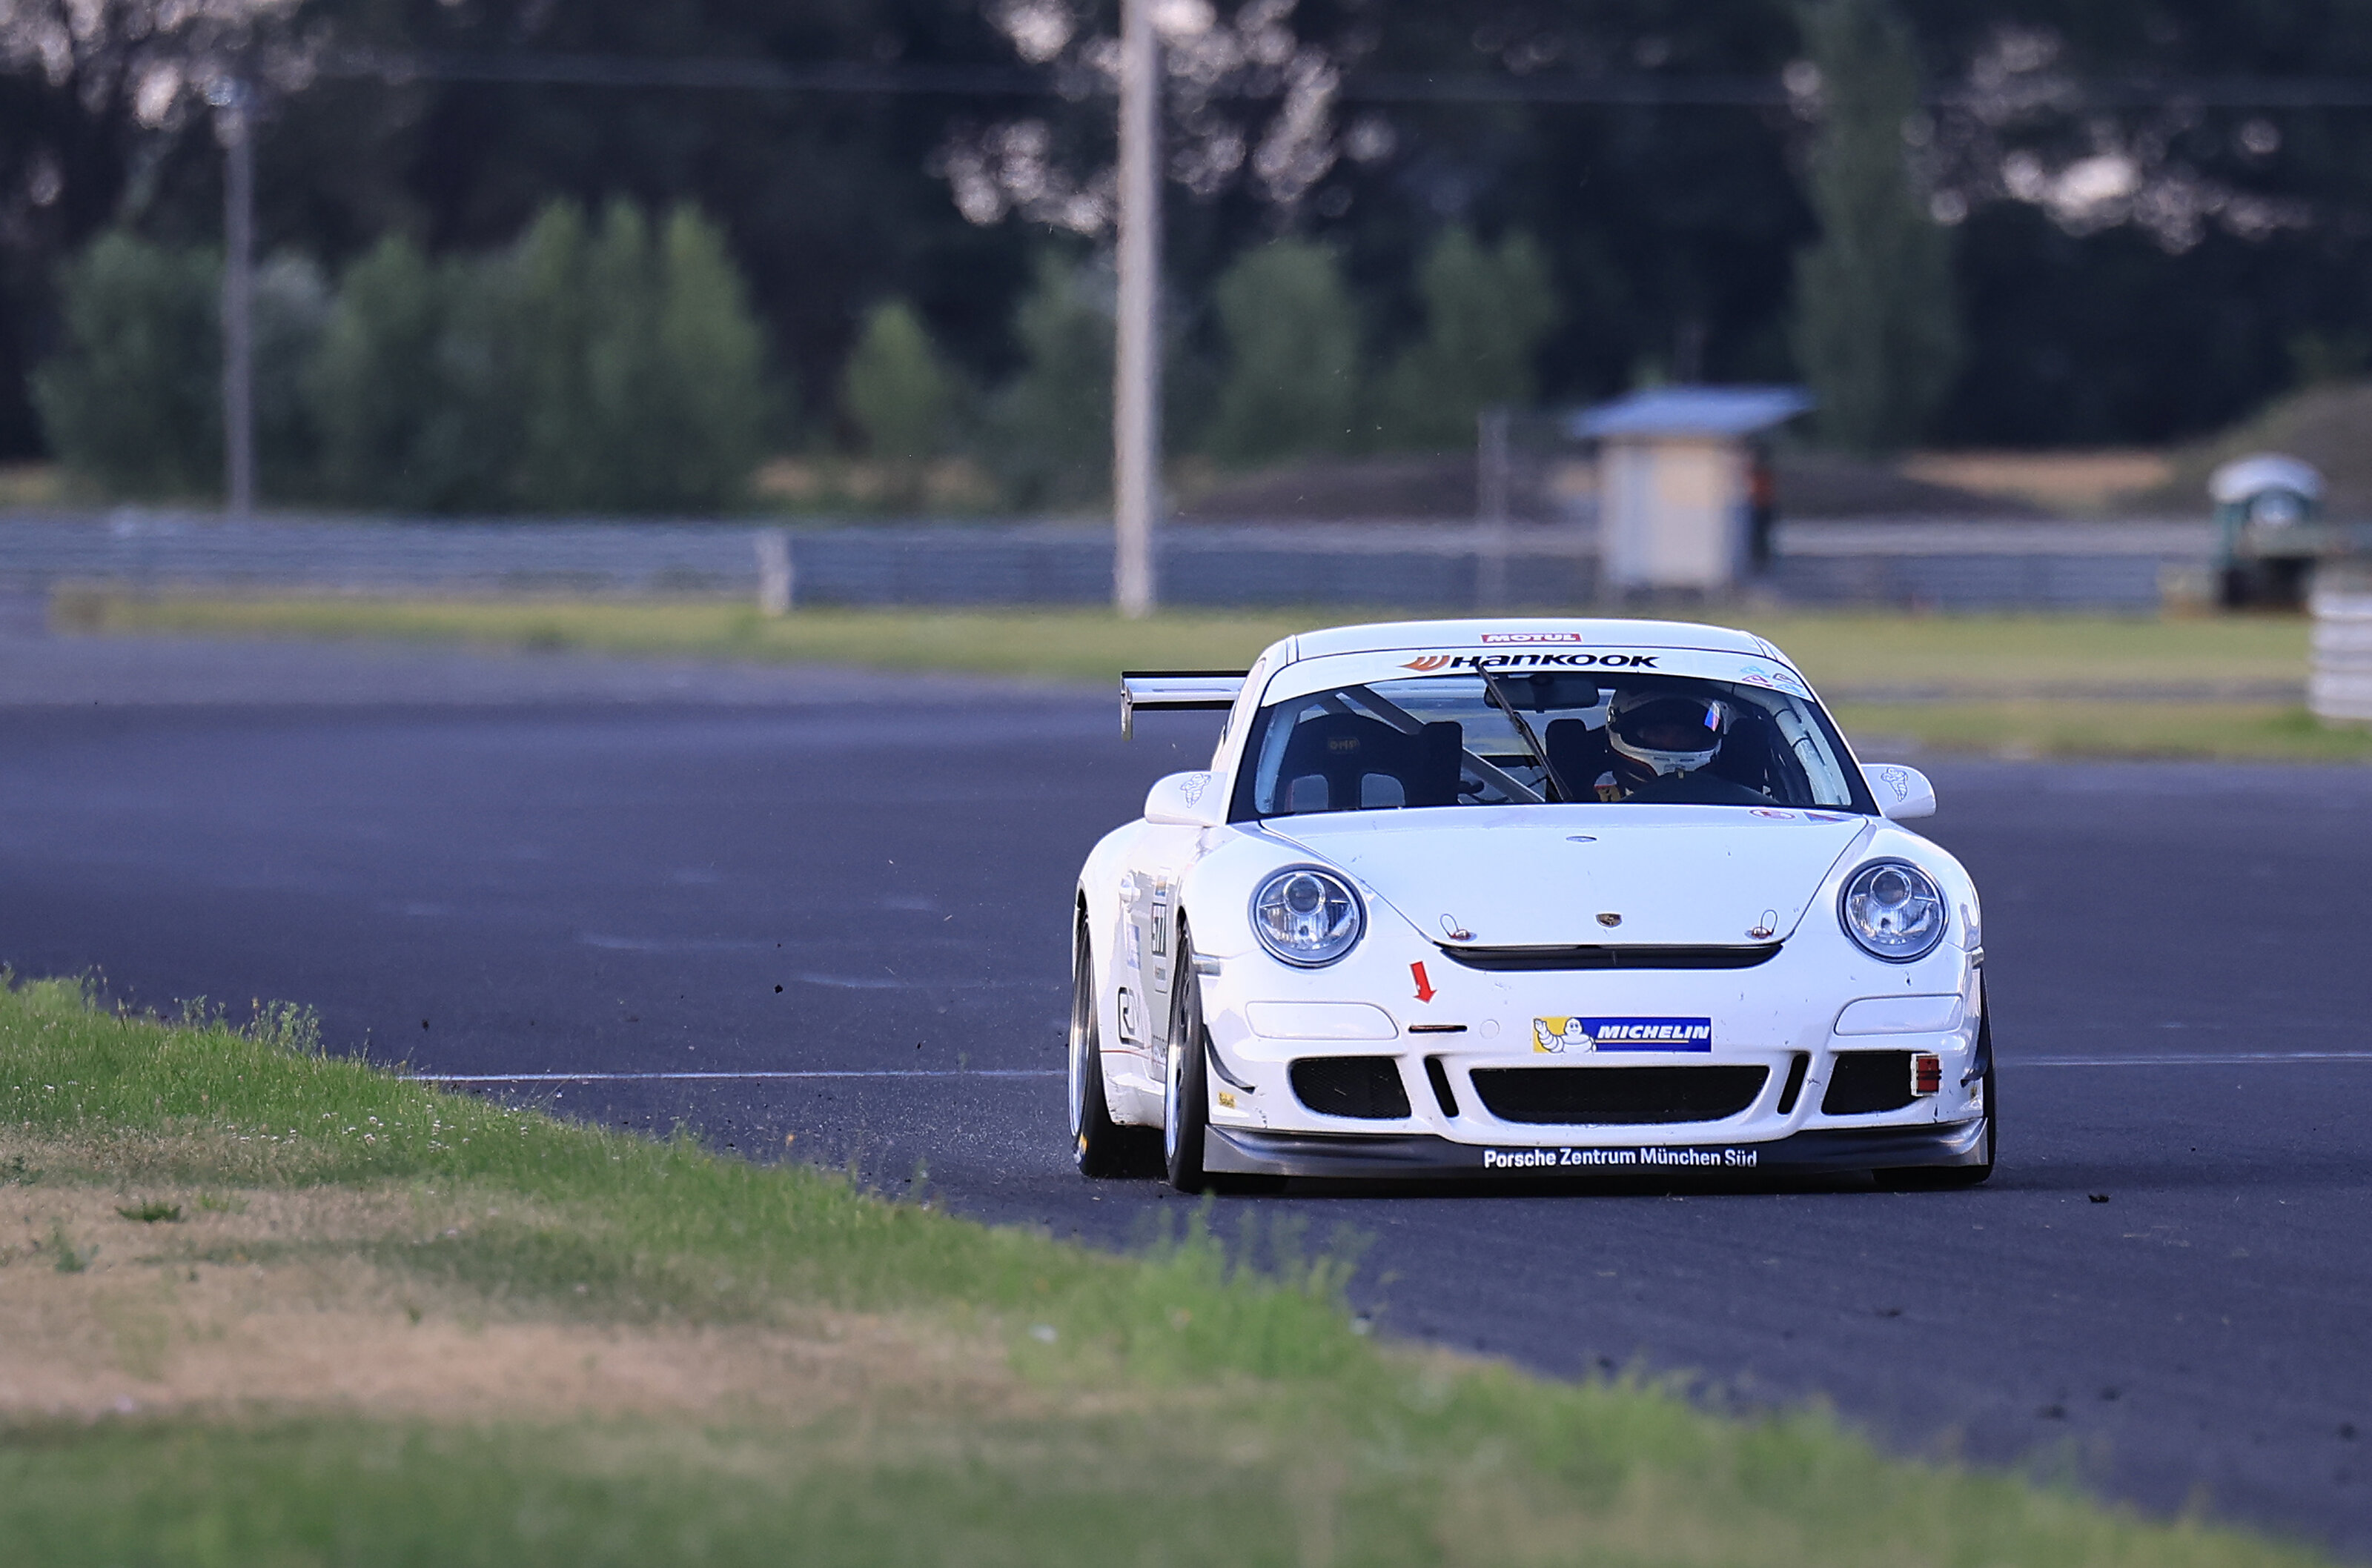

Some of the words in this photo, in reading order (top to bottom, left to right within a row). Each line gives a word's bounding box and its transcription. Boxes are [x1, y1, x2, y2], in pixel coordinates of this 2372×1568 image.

[1485, 634, 1577, 642] MOTUL
[1597, 1026, 1710, 1039] MICHELIN
[1484, 1149, 1557, 1169] Porsche
[1560, 1148, 1636, 1166] Zentrum
[1640, 1148, 1720, 1166] München
[1725, 1149, 1758, 1168] Süd
